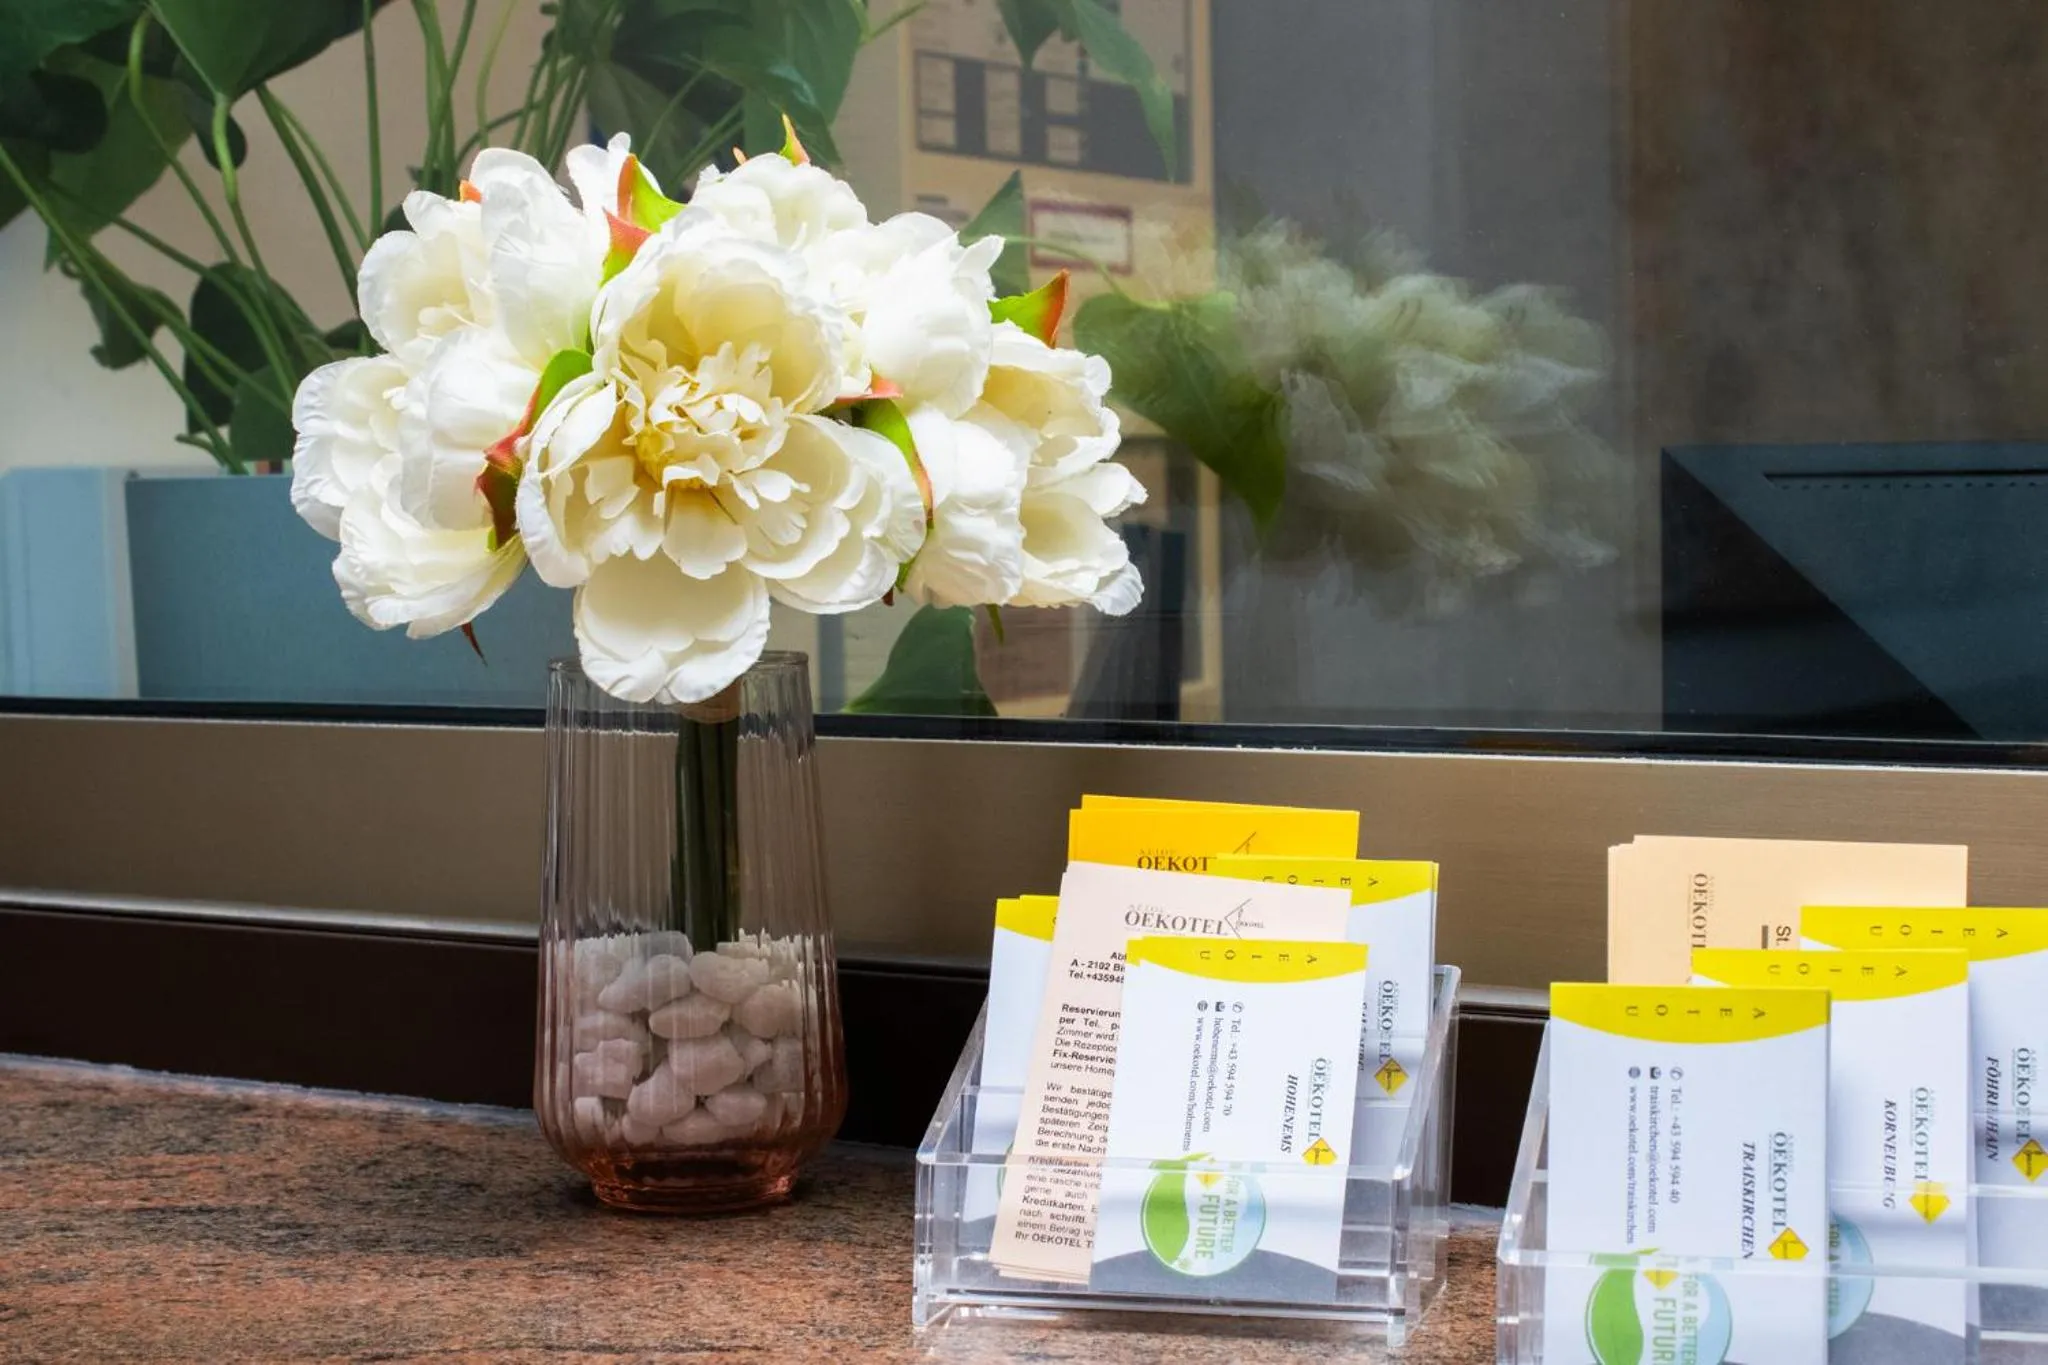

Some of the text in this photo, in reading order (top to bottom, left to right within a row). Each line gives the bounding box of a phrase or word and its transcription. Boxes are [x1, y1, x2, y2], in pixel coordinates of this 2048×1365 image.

[1125, 910, 1229, 935] OEKOTEL
[1088, 960, 1111, 970] 2102
[1059, 1016, 1076, 1025] per
[1084, 1017, 1100, 1028] Tel.
[1057, 1027, 1092, 1038] Zimmer
[1055, 1037, 1071, 1046] Die
[1050, 1062, 1082, 1073] unsere
[1044, 1095, 1078, 1105] senden
[1308, 1058, 1327, 1142] OEKOTEL
[1280, 1074, 1298, 1153] HOHENEMS
[1037, 1126, 1094, 1142] Berechnung
[1052, 1142, 1076, 1151] erste
[1772, 1132, 1787, 1233] OEKOTEL
[1024, 1185, 1088, 1199] gerne auch
[1019, 1208, 1042, 1218] nach
[1017, 1220, 1047, 1231] einem
[1049, 1224, 1081, 1236] Betrag
[1195, 1194, 1221, 1259] FUTURE
[1015, 1231, 1029, 1240] Ihr
[1032, 1233, 1081, 1248] OEKOTEL
